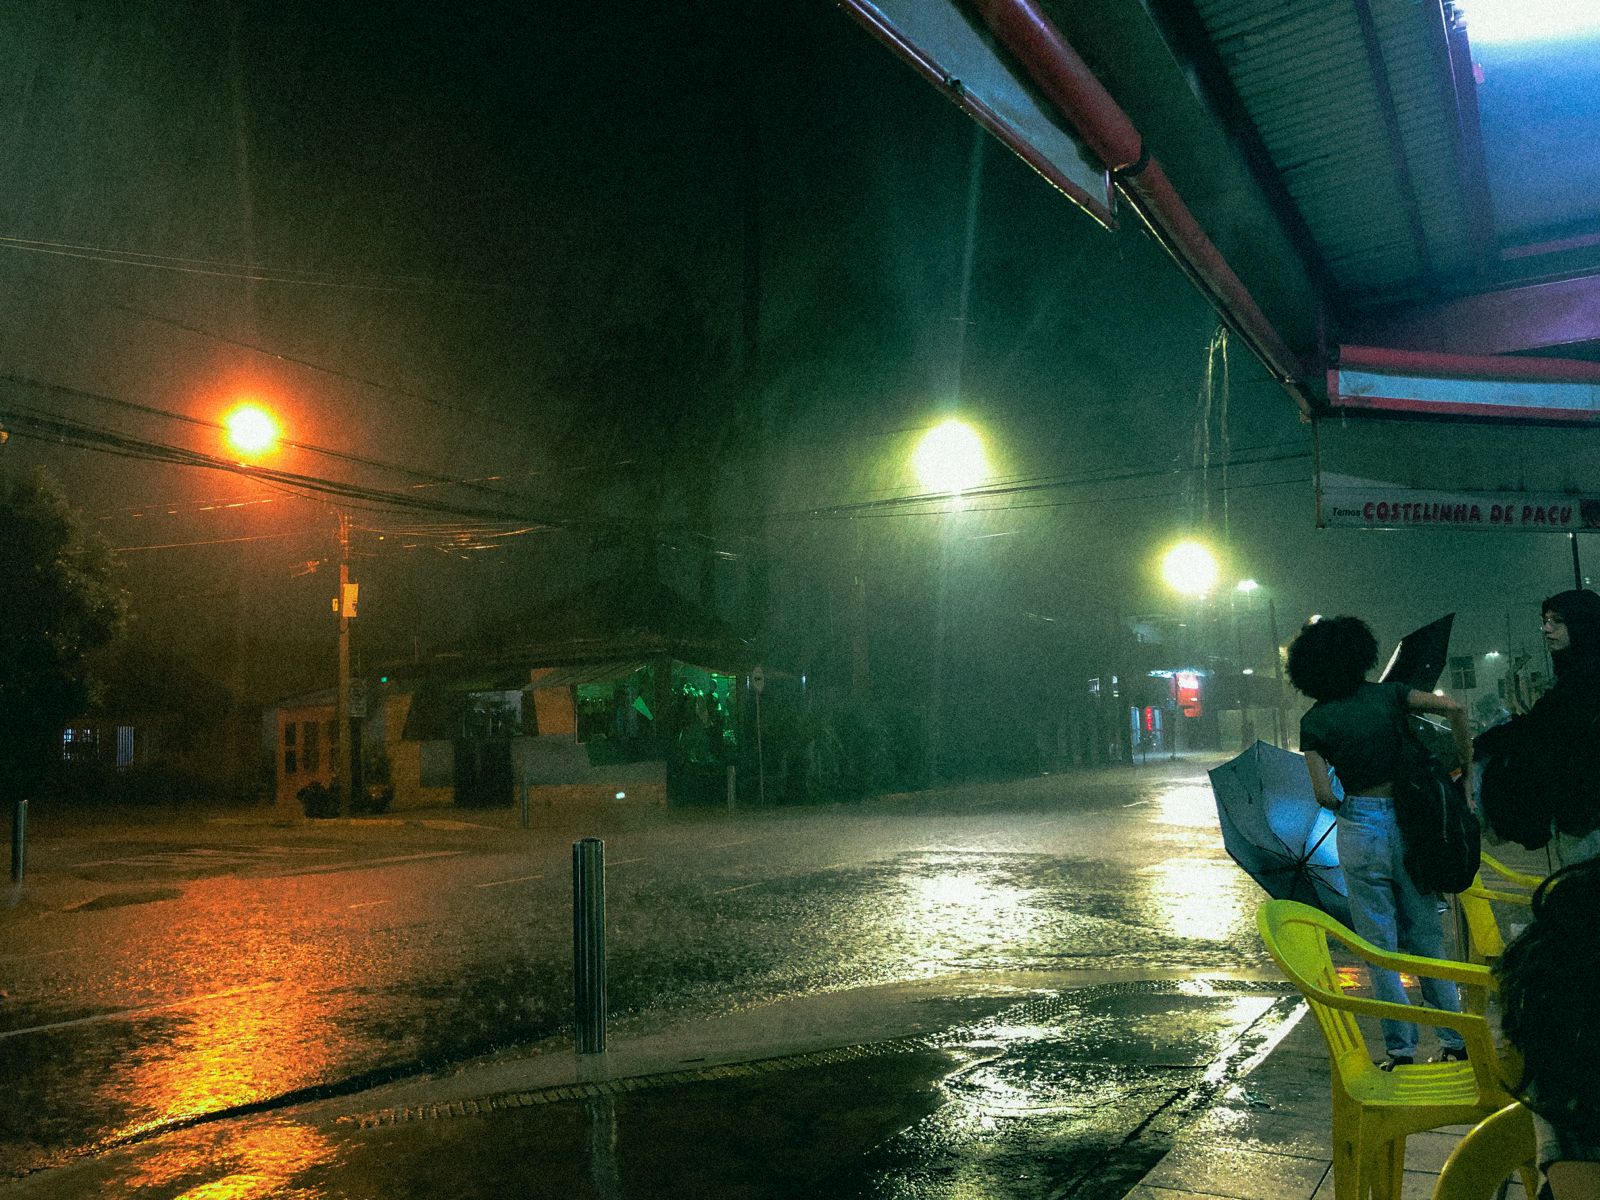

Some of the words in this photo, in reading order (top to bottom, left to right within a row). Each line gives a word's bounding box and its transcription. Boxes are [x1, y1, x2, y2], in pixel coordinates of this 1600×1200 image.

[1363, 502, 1481, 523] COSTELINHA
[1490, 504, 1514, 524] DE
[1521, 505, 1572, 526] PACU
